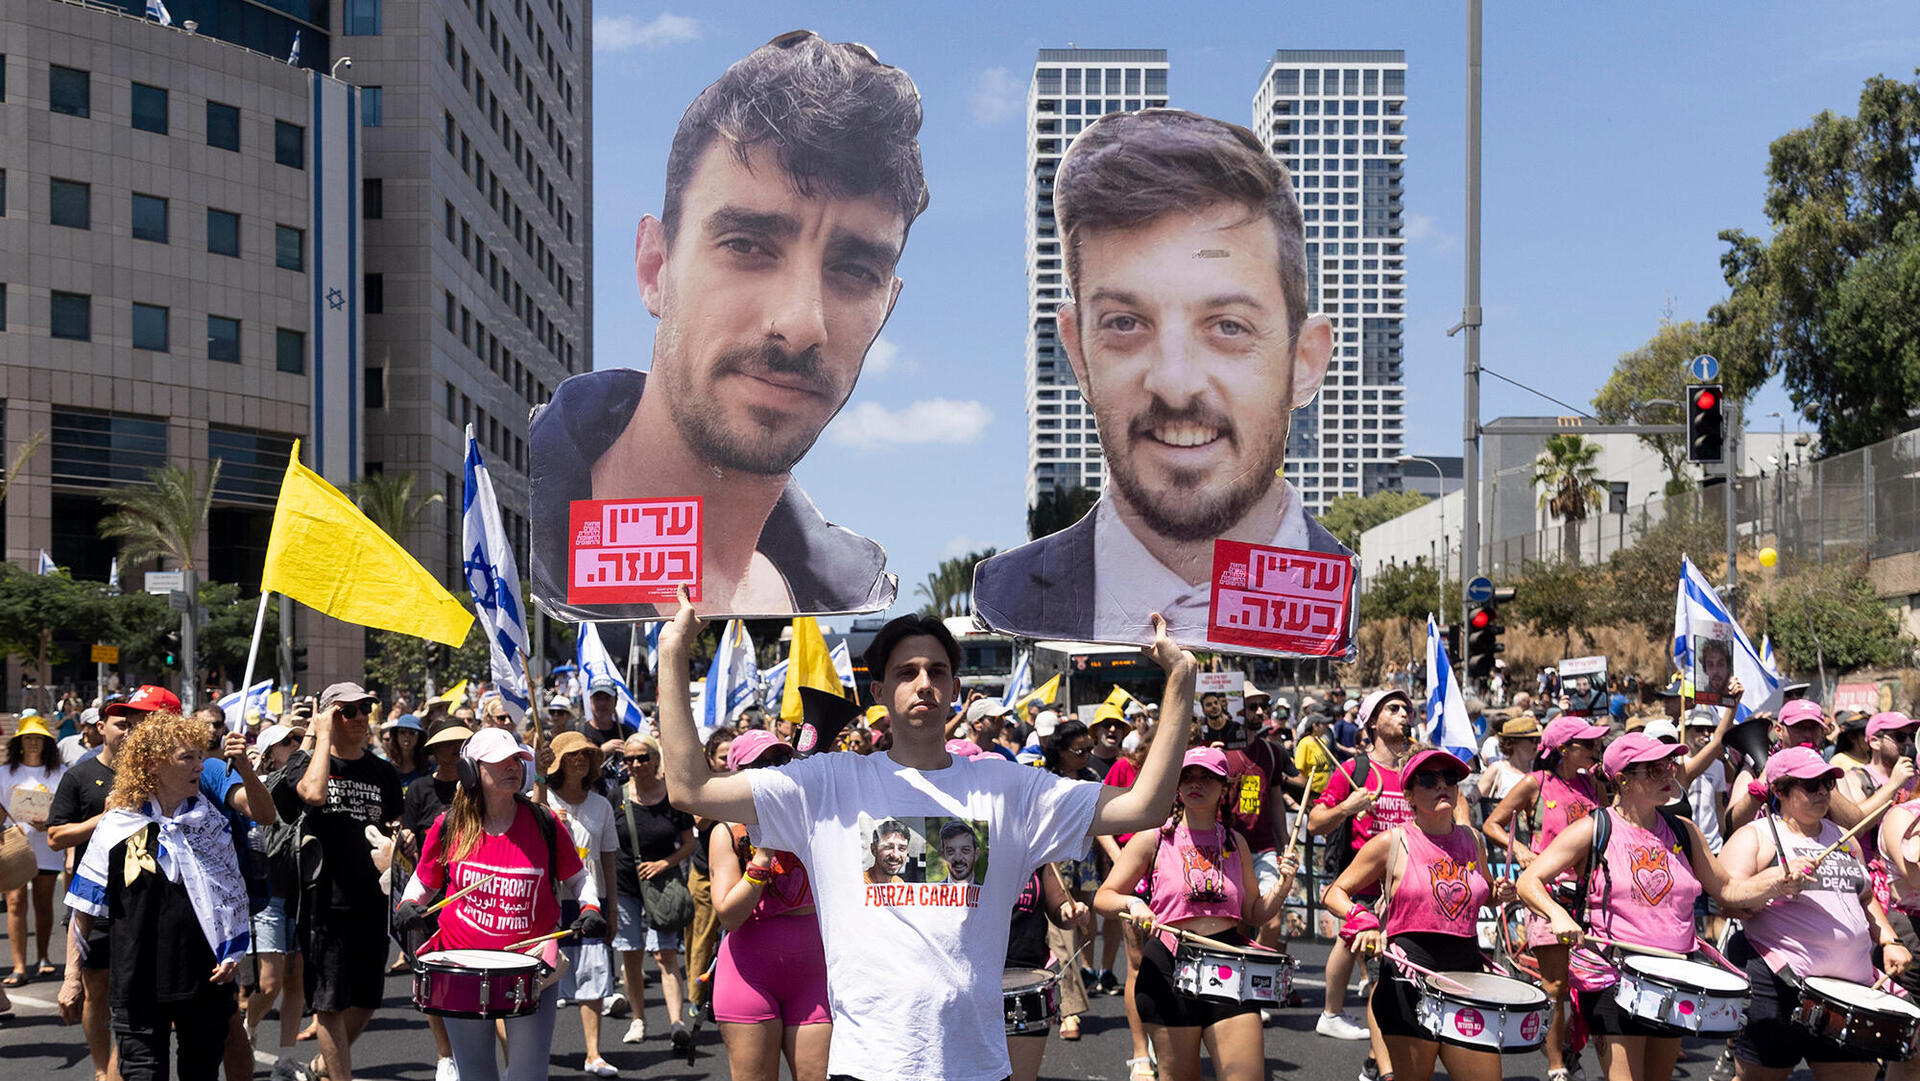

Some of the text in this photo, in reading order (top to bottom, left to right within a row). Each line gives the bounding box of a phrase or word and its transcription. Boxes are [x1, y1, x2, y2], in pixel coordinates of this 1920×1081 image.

[608, 506, 693, 543] עדיין
[587, 551, 694, 583] בעזה.
[1255, 554, 1341, 592] עדיין
[1229, 596, 1338, 636] בעזה.
[328, 779, 381, 794] ALESTINIAN
[865, 885, 915, 907] FUERZA
[1822, 877, 1855, 890] DEAL
